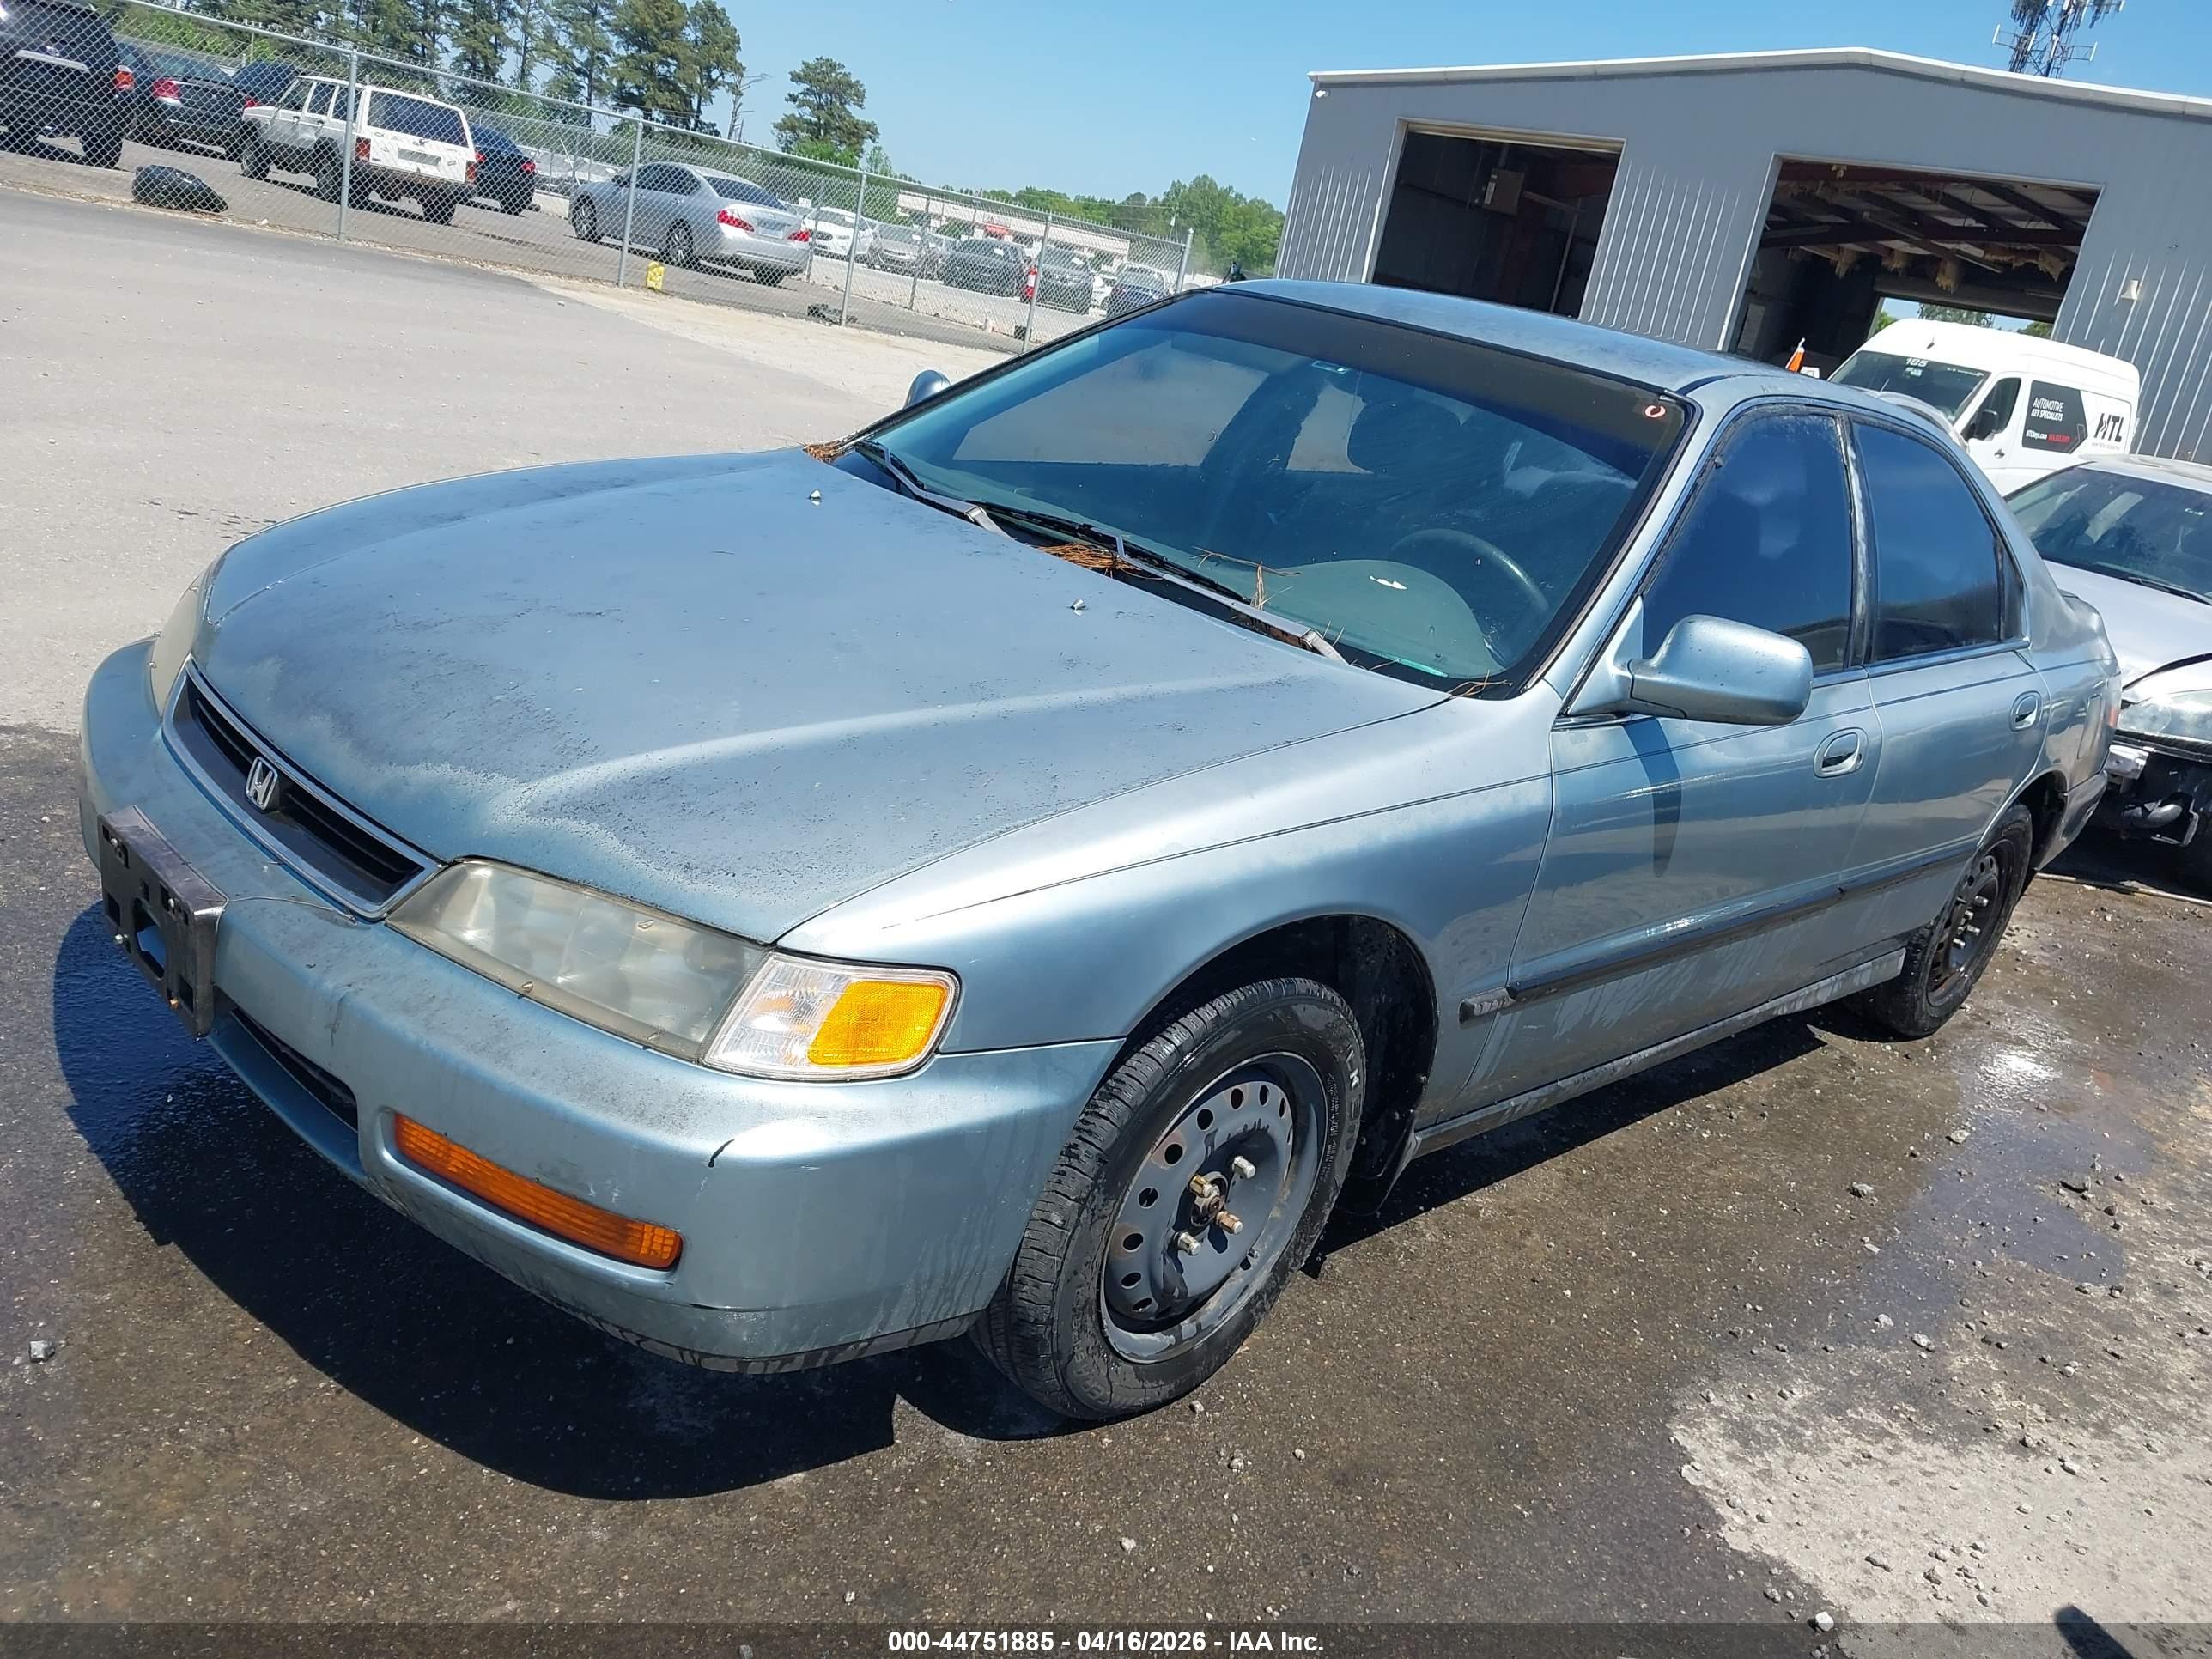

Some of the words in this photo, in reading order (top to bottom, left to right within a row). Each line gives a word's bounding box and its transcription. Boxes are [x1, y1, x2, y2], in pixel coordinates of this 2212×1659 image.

[2032, 398, 2064, 412] AUTOMOTIVE
[2031, 408, 2041, 417] KEY
[2039, 410, 2063, 422] SPECIALISTS
